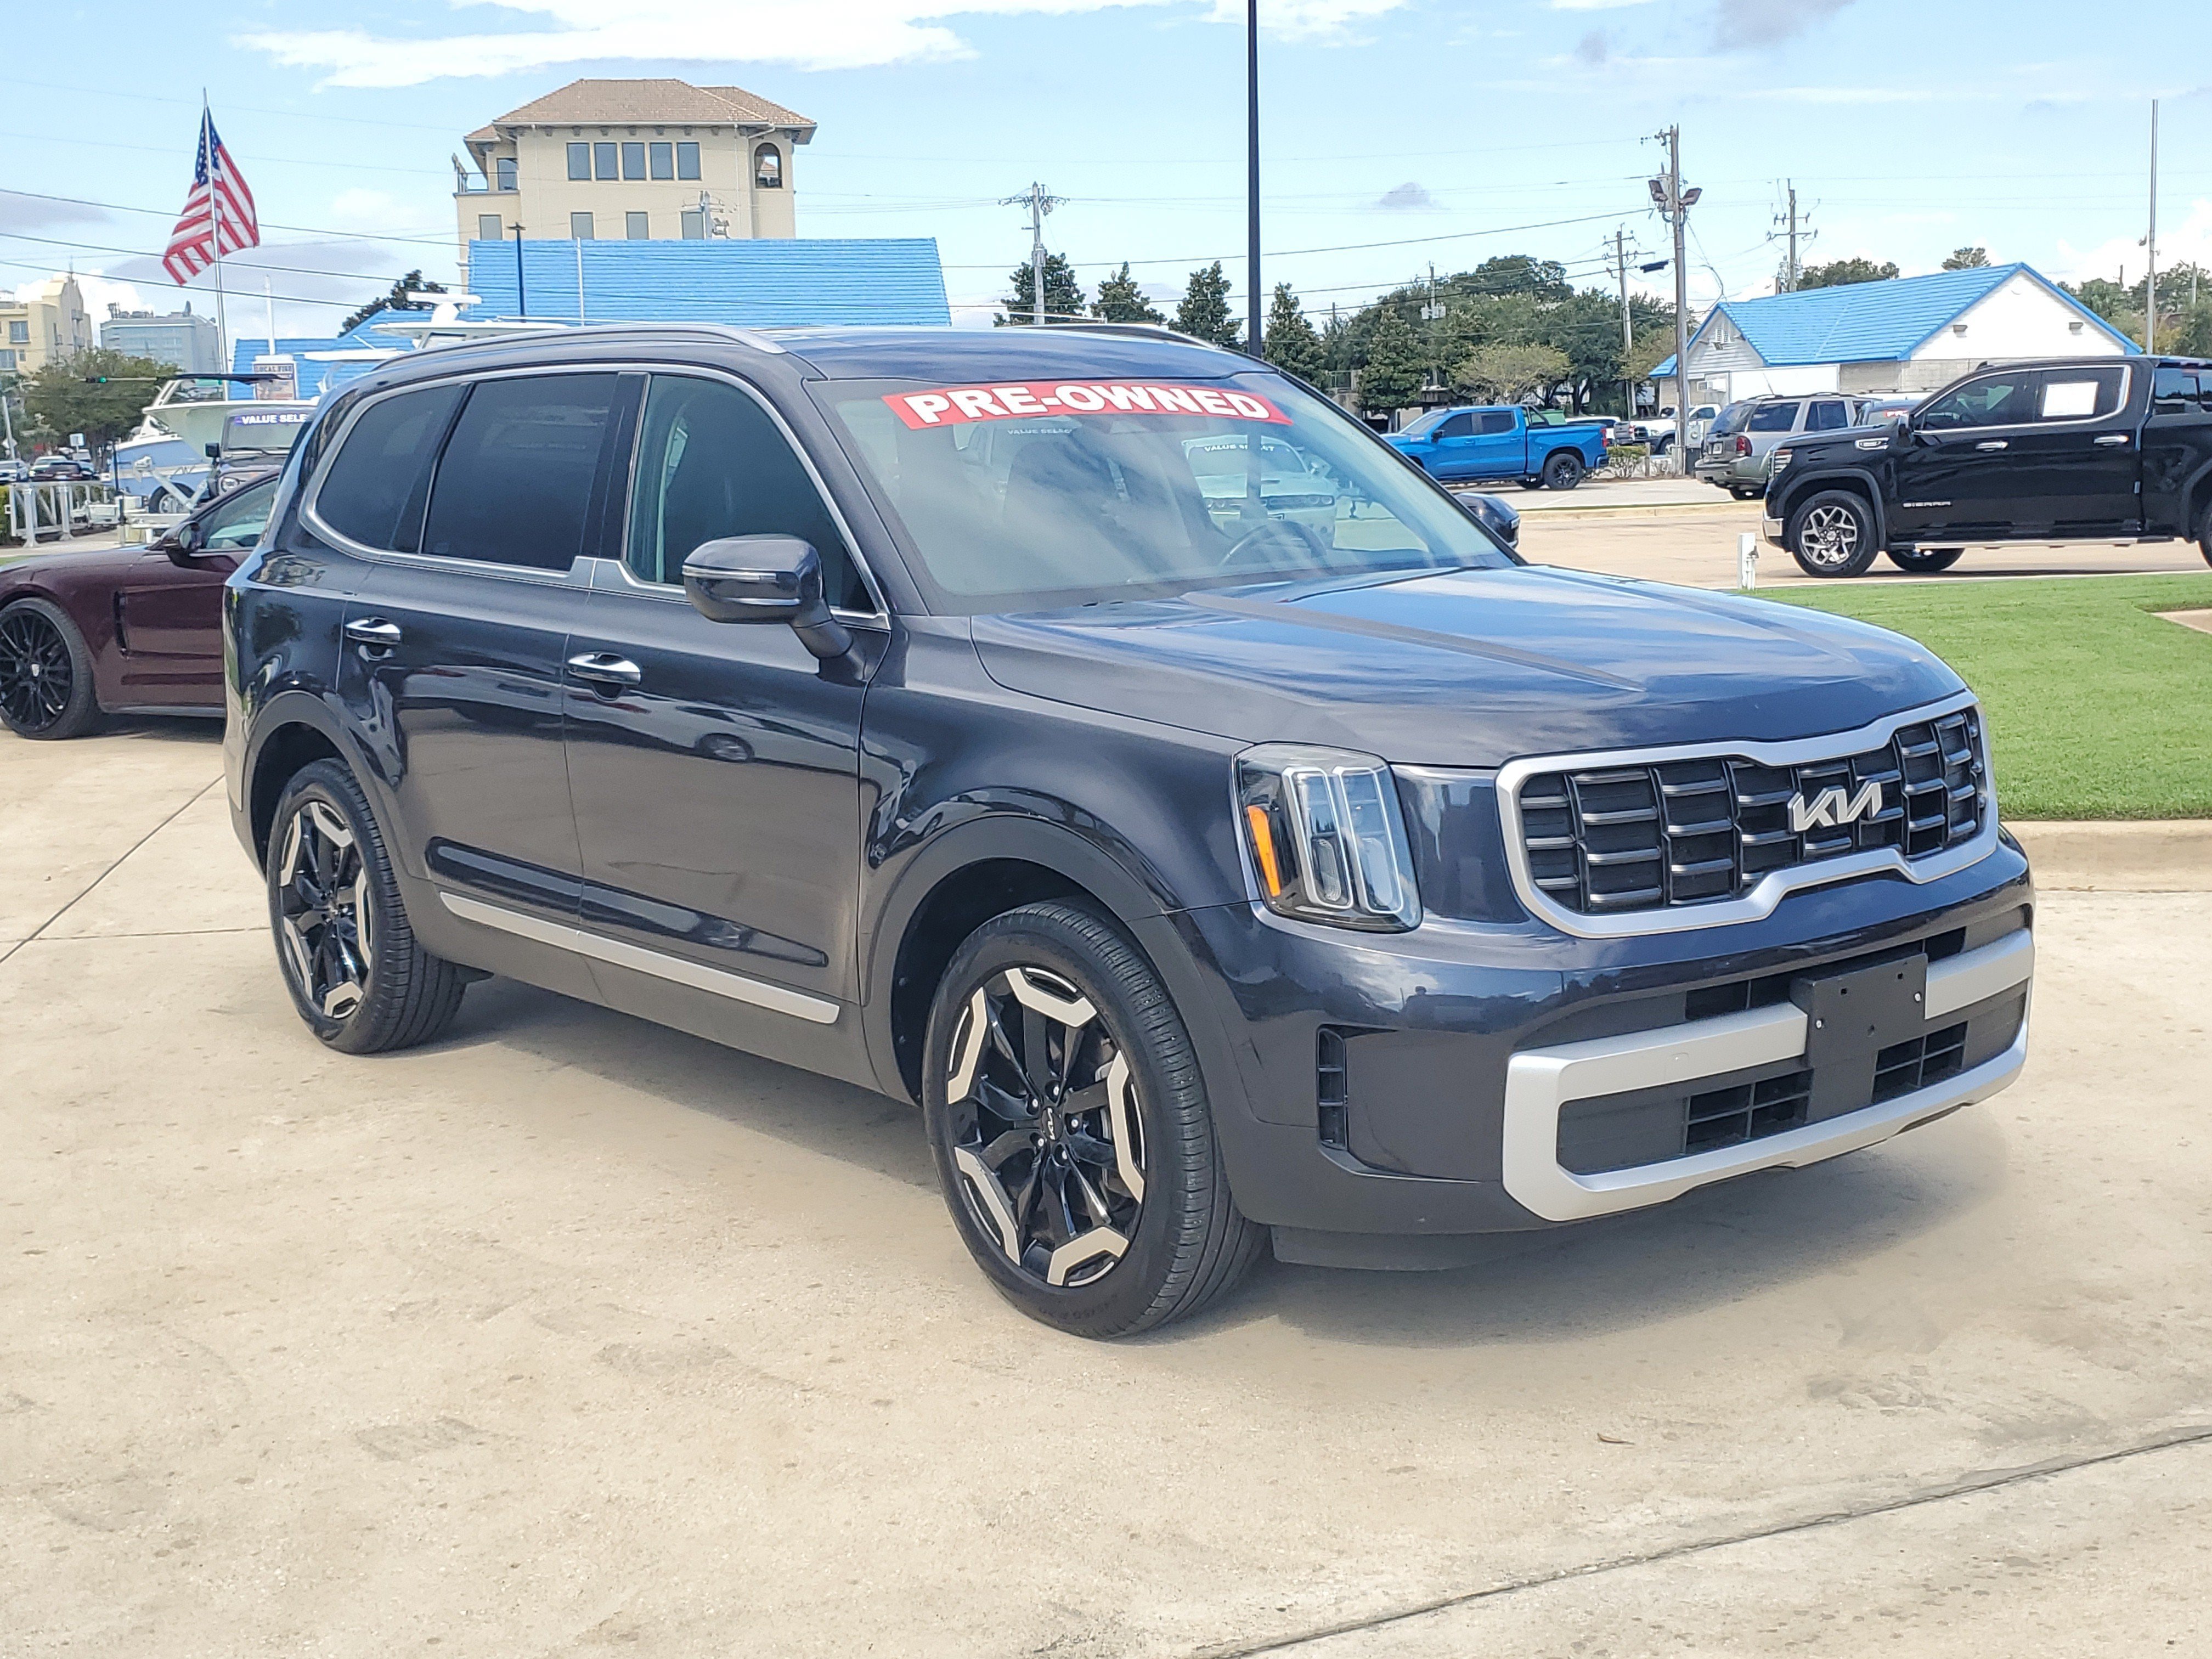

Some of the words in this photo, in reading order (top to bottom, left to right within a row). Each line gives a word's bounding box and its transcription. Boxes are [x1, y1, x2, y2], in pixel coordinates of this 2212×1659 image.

[242, 415, 278, 424] VALUE
[279, 414, 307, 422] SELE
[904, 385, 1269, 424] PRE-OWNED
[1787, 780, 1882, 832] KIA
